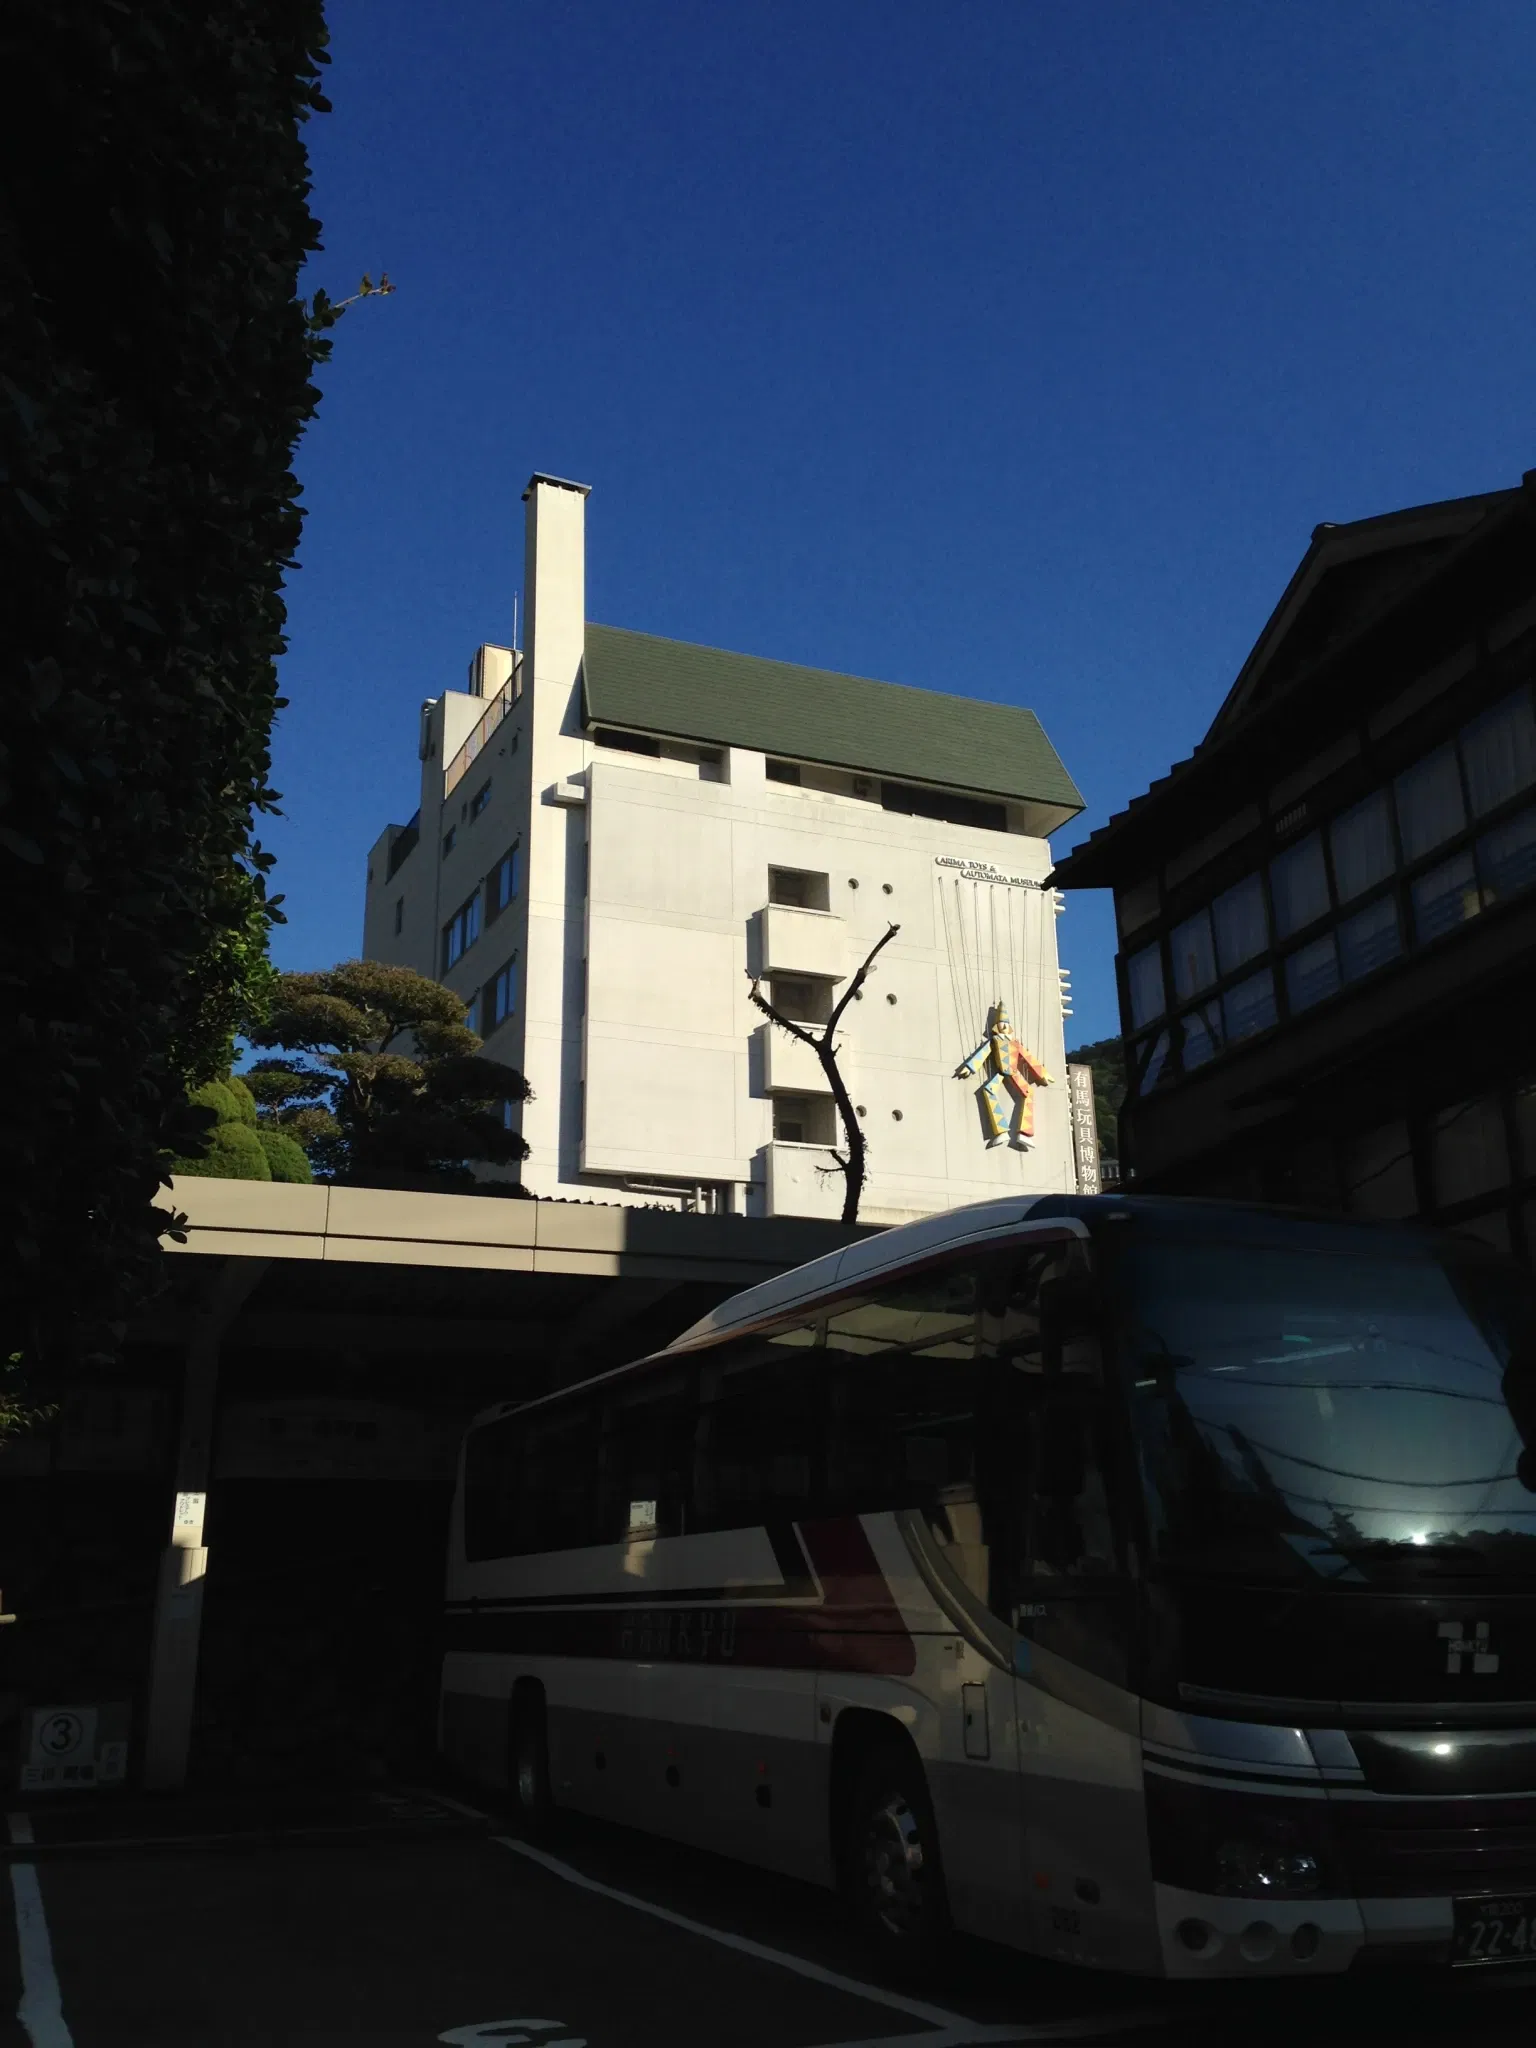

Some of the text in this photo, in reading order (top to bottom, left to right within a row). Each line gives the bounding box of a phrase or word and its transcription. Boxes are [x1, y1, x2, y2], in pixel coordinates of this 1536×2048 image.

[940, 857, 966, 867] ARIMA
[968, 861, 987, 871] TOYS
[965, 870, 1008, 883] AUTOMATA
